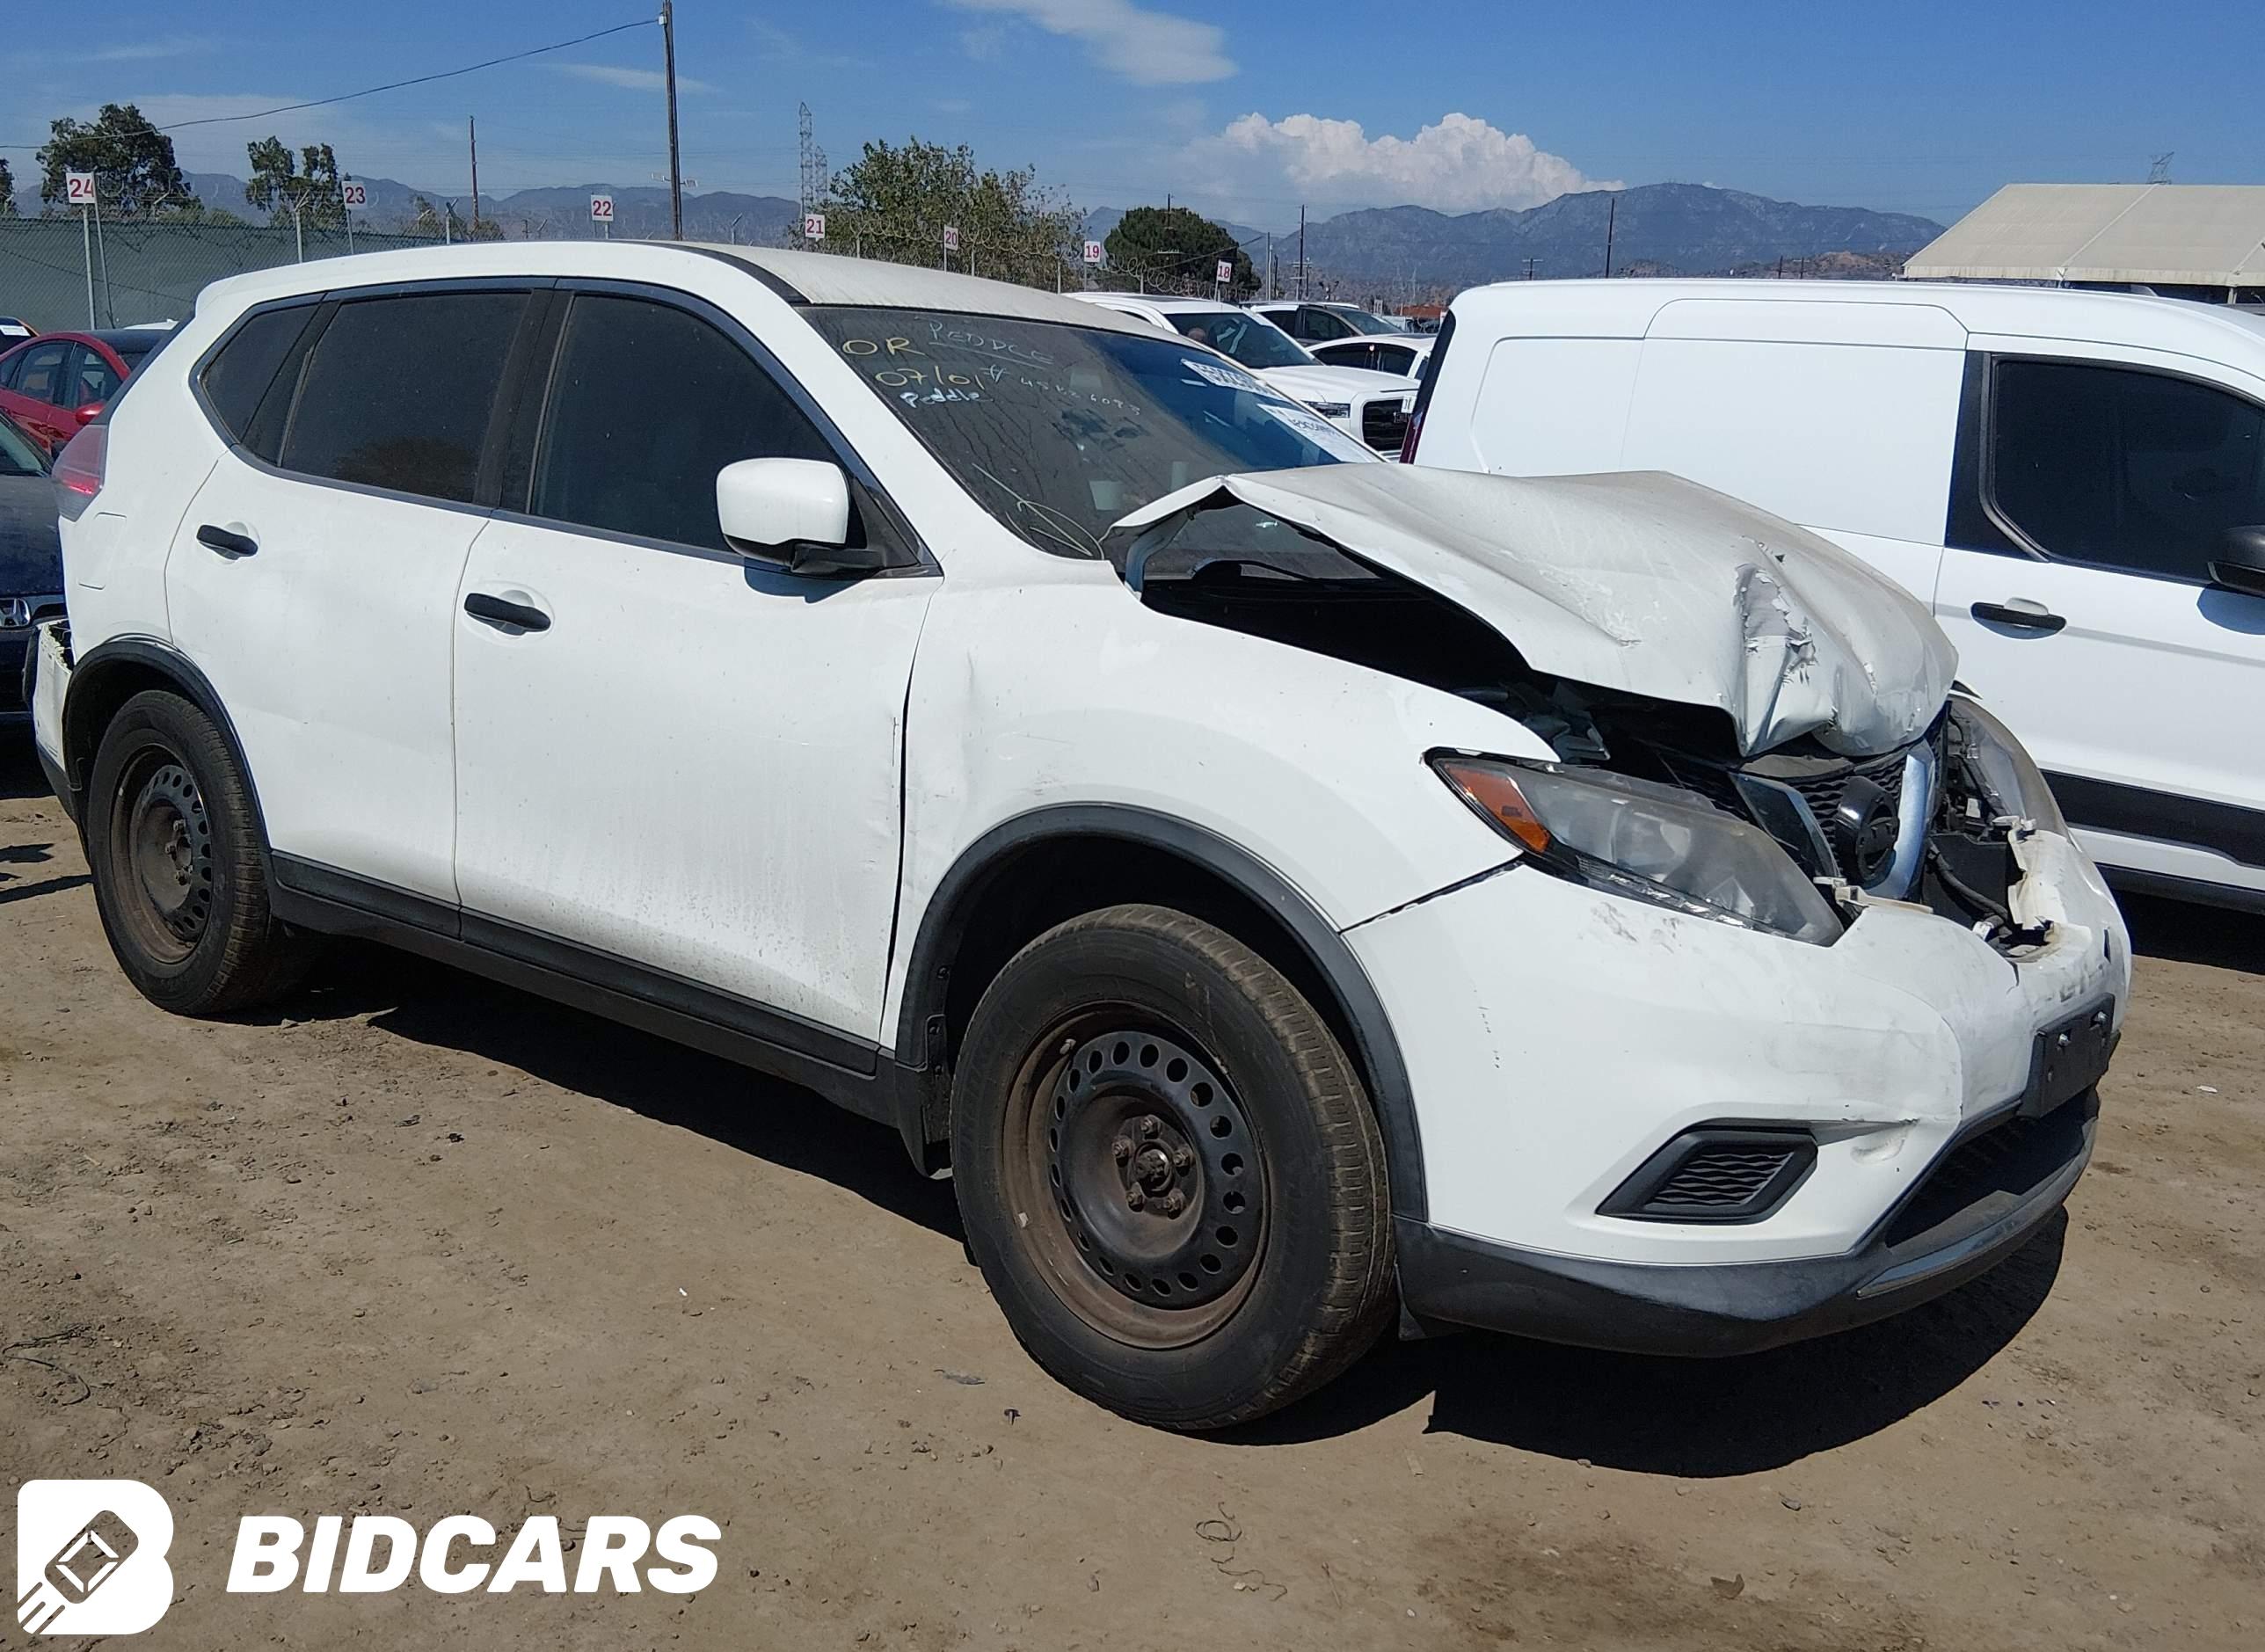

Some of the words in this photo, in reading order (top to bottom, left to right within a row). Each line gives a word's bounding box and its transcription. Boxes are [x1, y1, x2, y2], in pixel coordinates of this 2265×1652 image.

[69, 178, 94, 198] 24
[345, 186, 366, 204] 23
[593, 200, 612, 217] 22
[806, 218, 824, 235] 21
[944, 230, 958, 247] 20
[1085, 244, 1100, 258] 19
[1217, 265, 1230, 280] 18
[842, 338, 926, 355] OR
